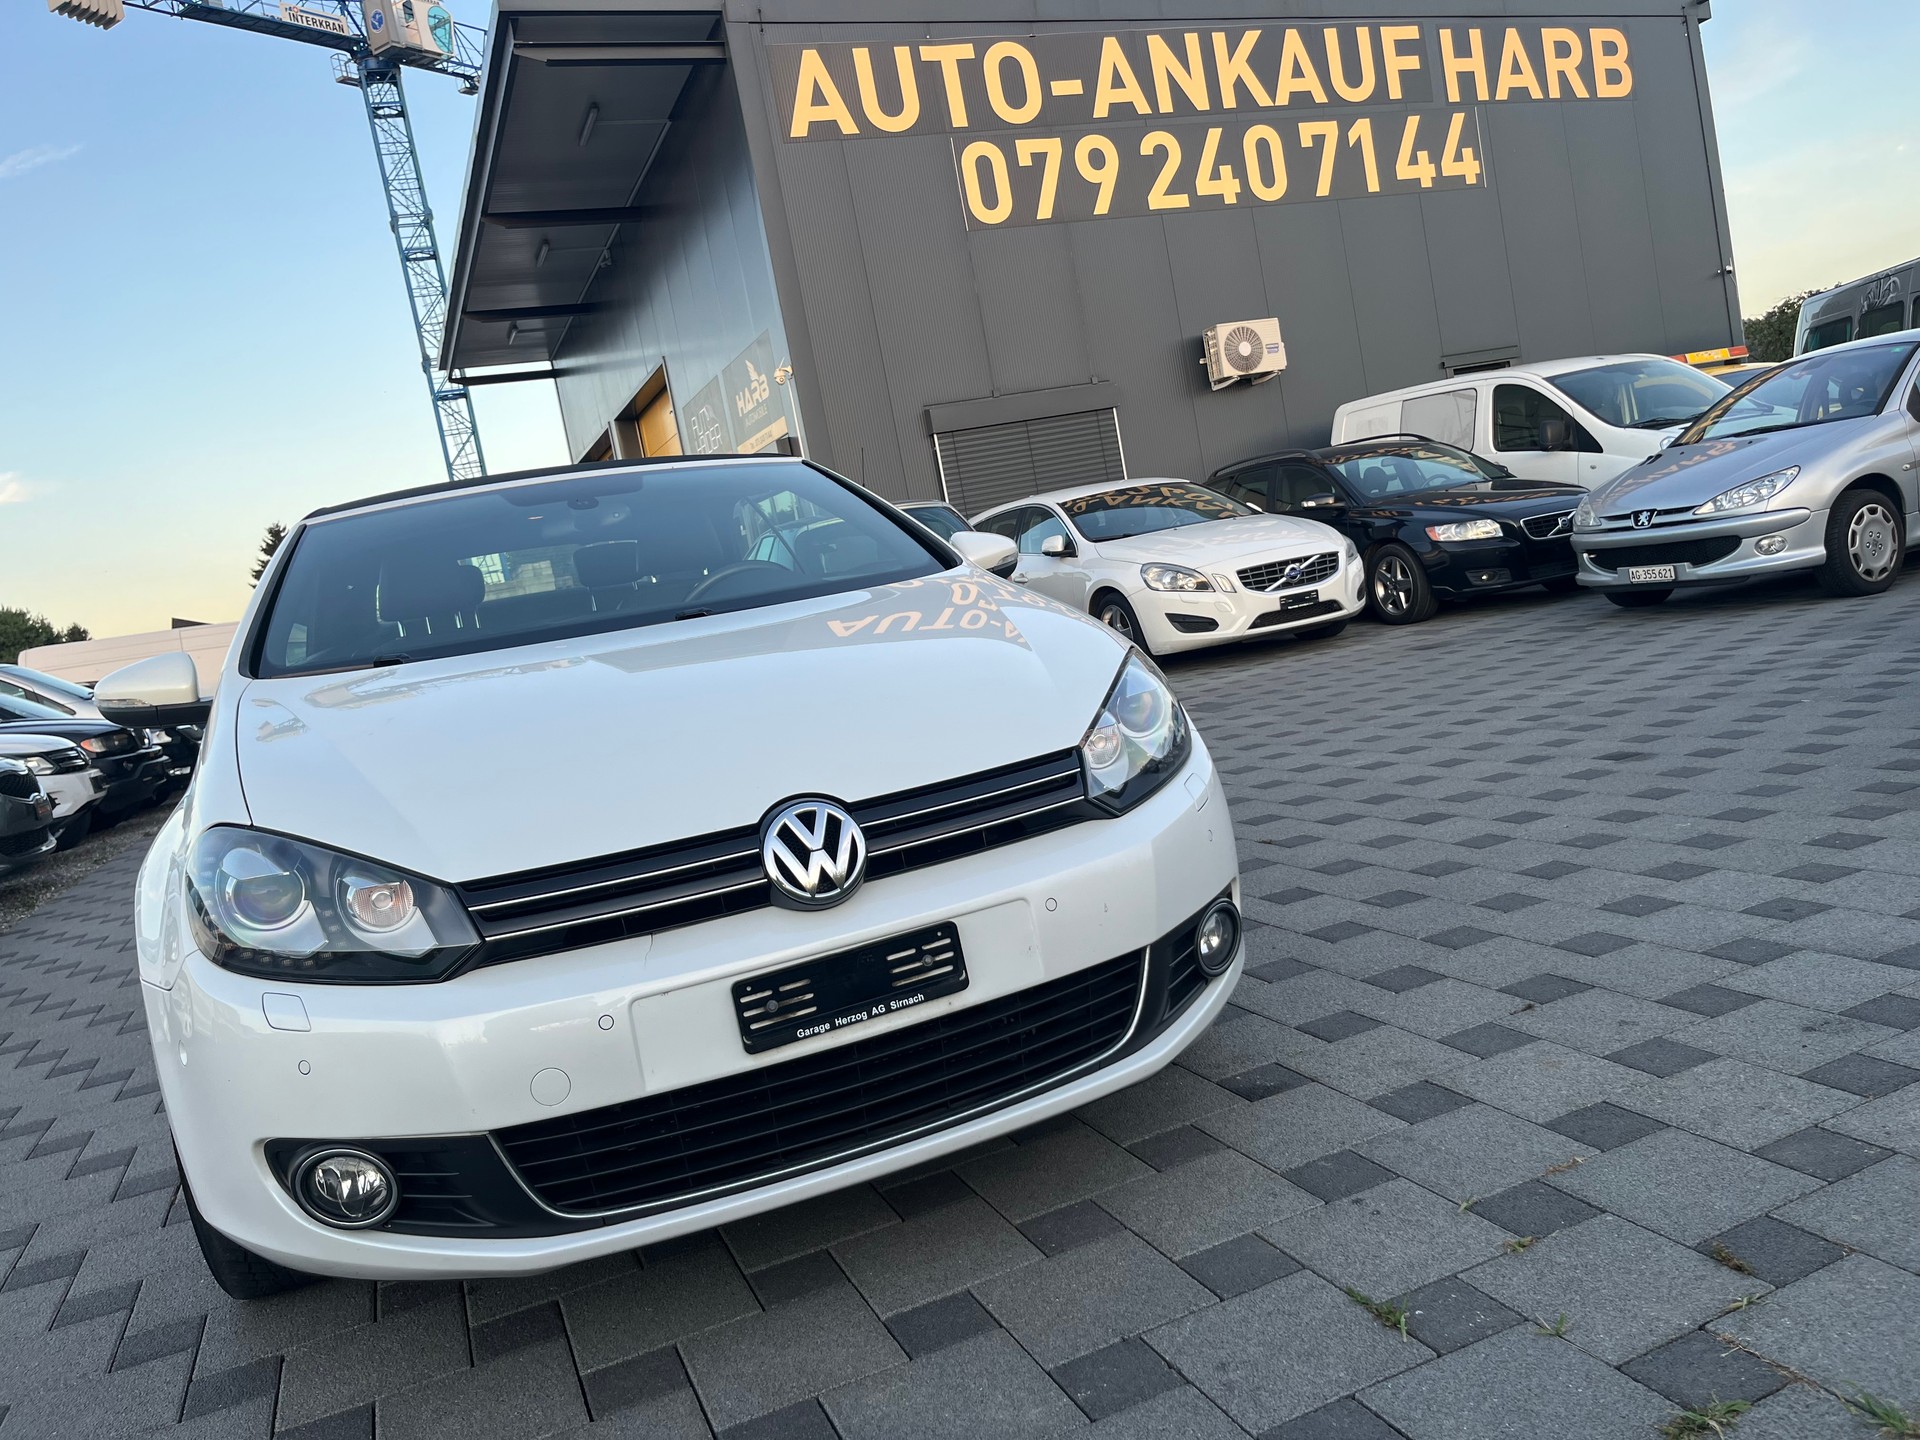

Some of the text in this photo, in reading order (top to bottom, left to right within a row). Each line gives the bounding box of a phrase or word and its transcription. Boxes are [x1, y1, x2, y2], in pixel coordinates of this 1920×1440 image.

[288, 12, 345, 34] INTERKRAN
[790, 26, 1633, 138] AUTO-ANKAUF HARB
[961, 134, 1120, 225] 079
[1140, 124, 1288, 210] 240
[735, 374, 770, 417] HARB
[1631, 570, 1641, 580] AG
[766, 804, 863, 902] VW
[796, 993, 925, 1038] Garage Herzog AG Sirnach
